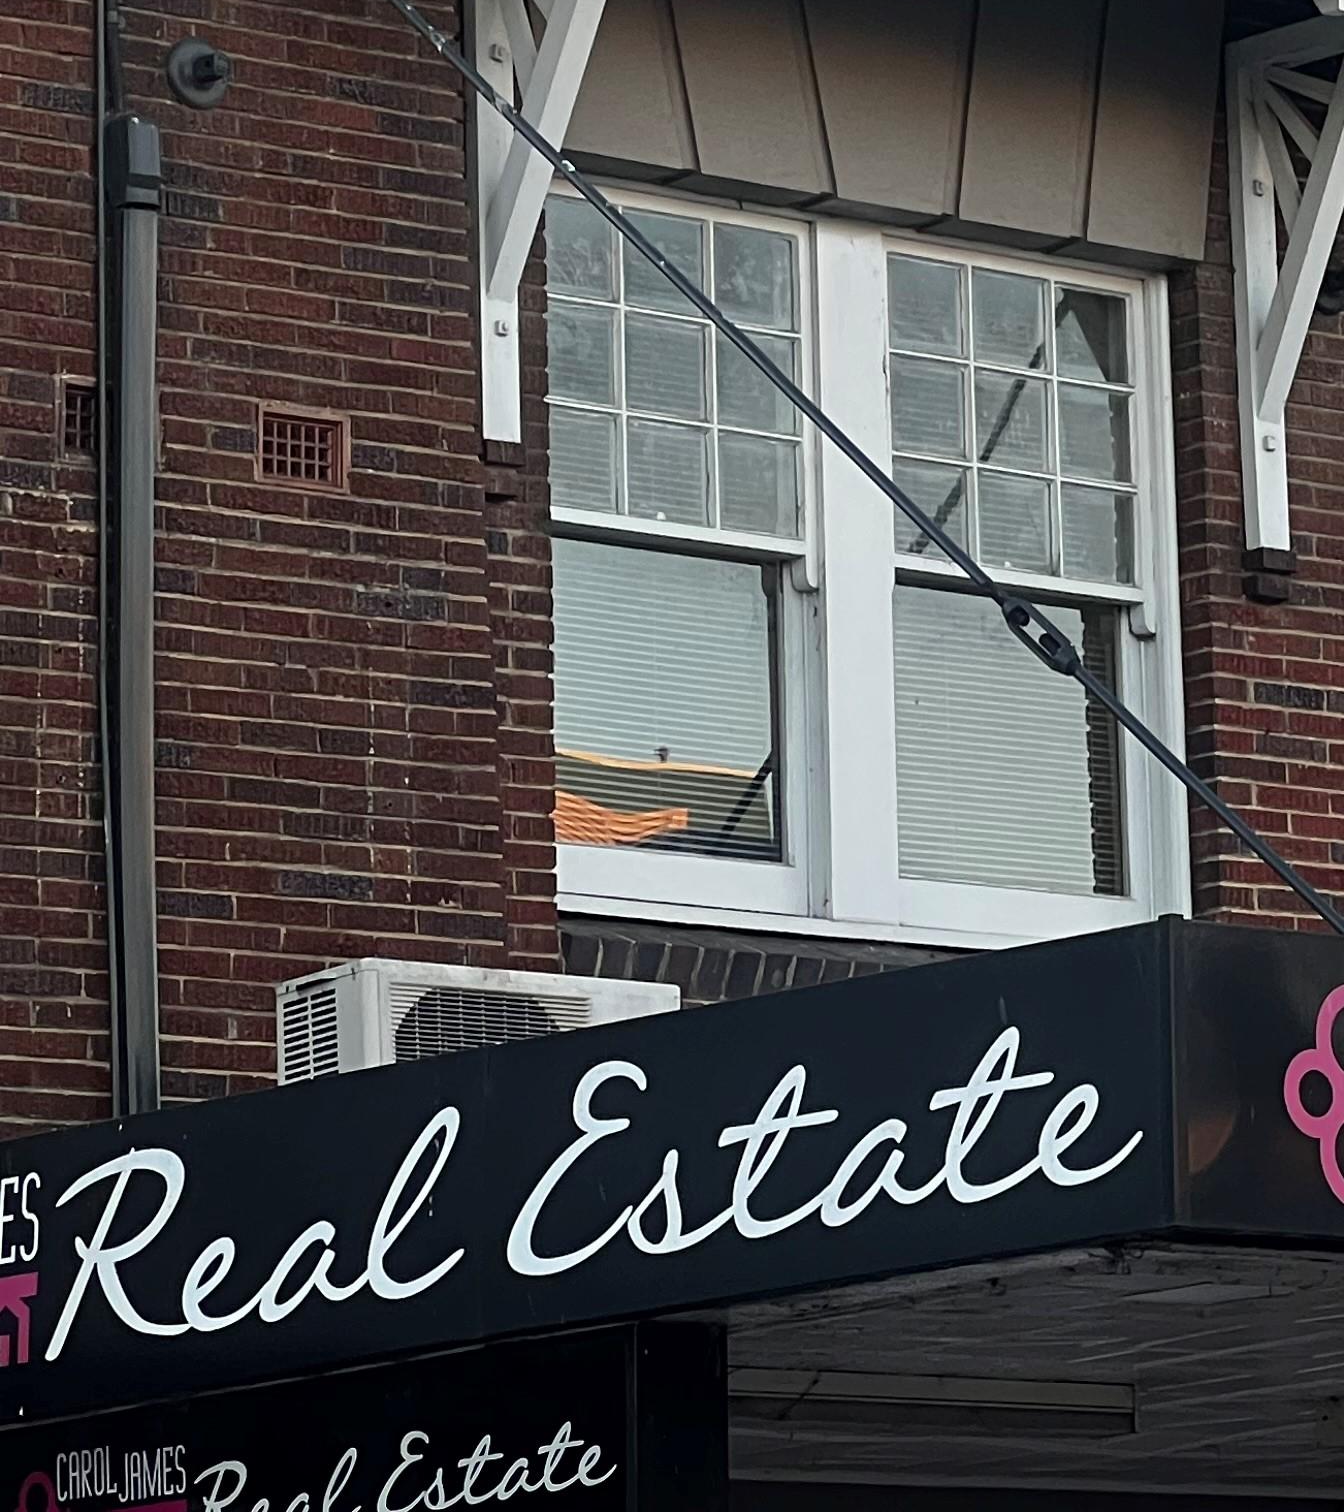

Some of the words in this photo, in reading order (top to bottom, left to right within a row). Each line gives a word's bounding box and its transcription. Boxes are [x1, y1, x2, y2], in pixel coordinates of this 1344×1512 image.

[44, 1104, 466, 1362] Real
[505, 1024, 1144, 1278] Estate
[56, 1444, 118, 1502] CAROL
[118, 1444, 187, 1501] JAMES
[376, 1420, 618, 1512] Estate
